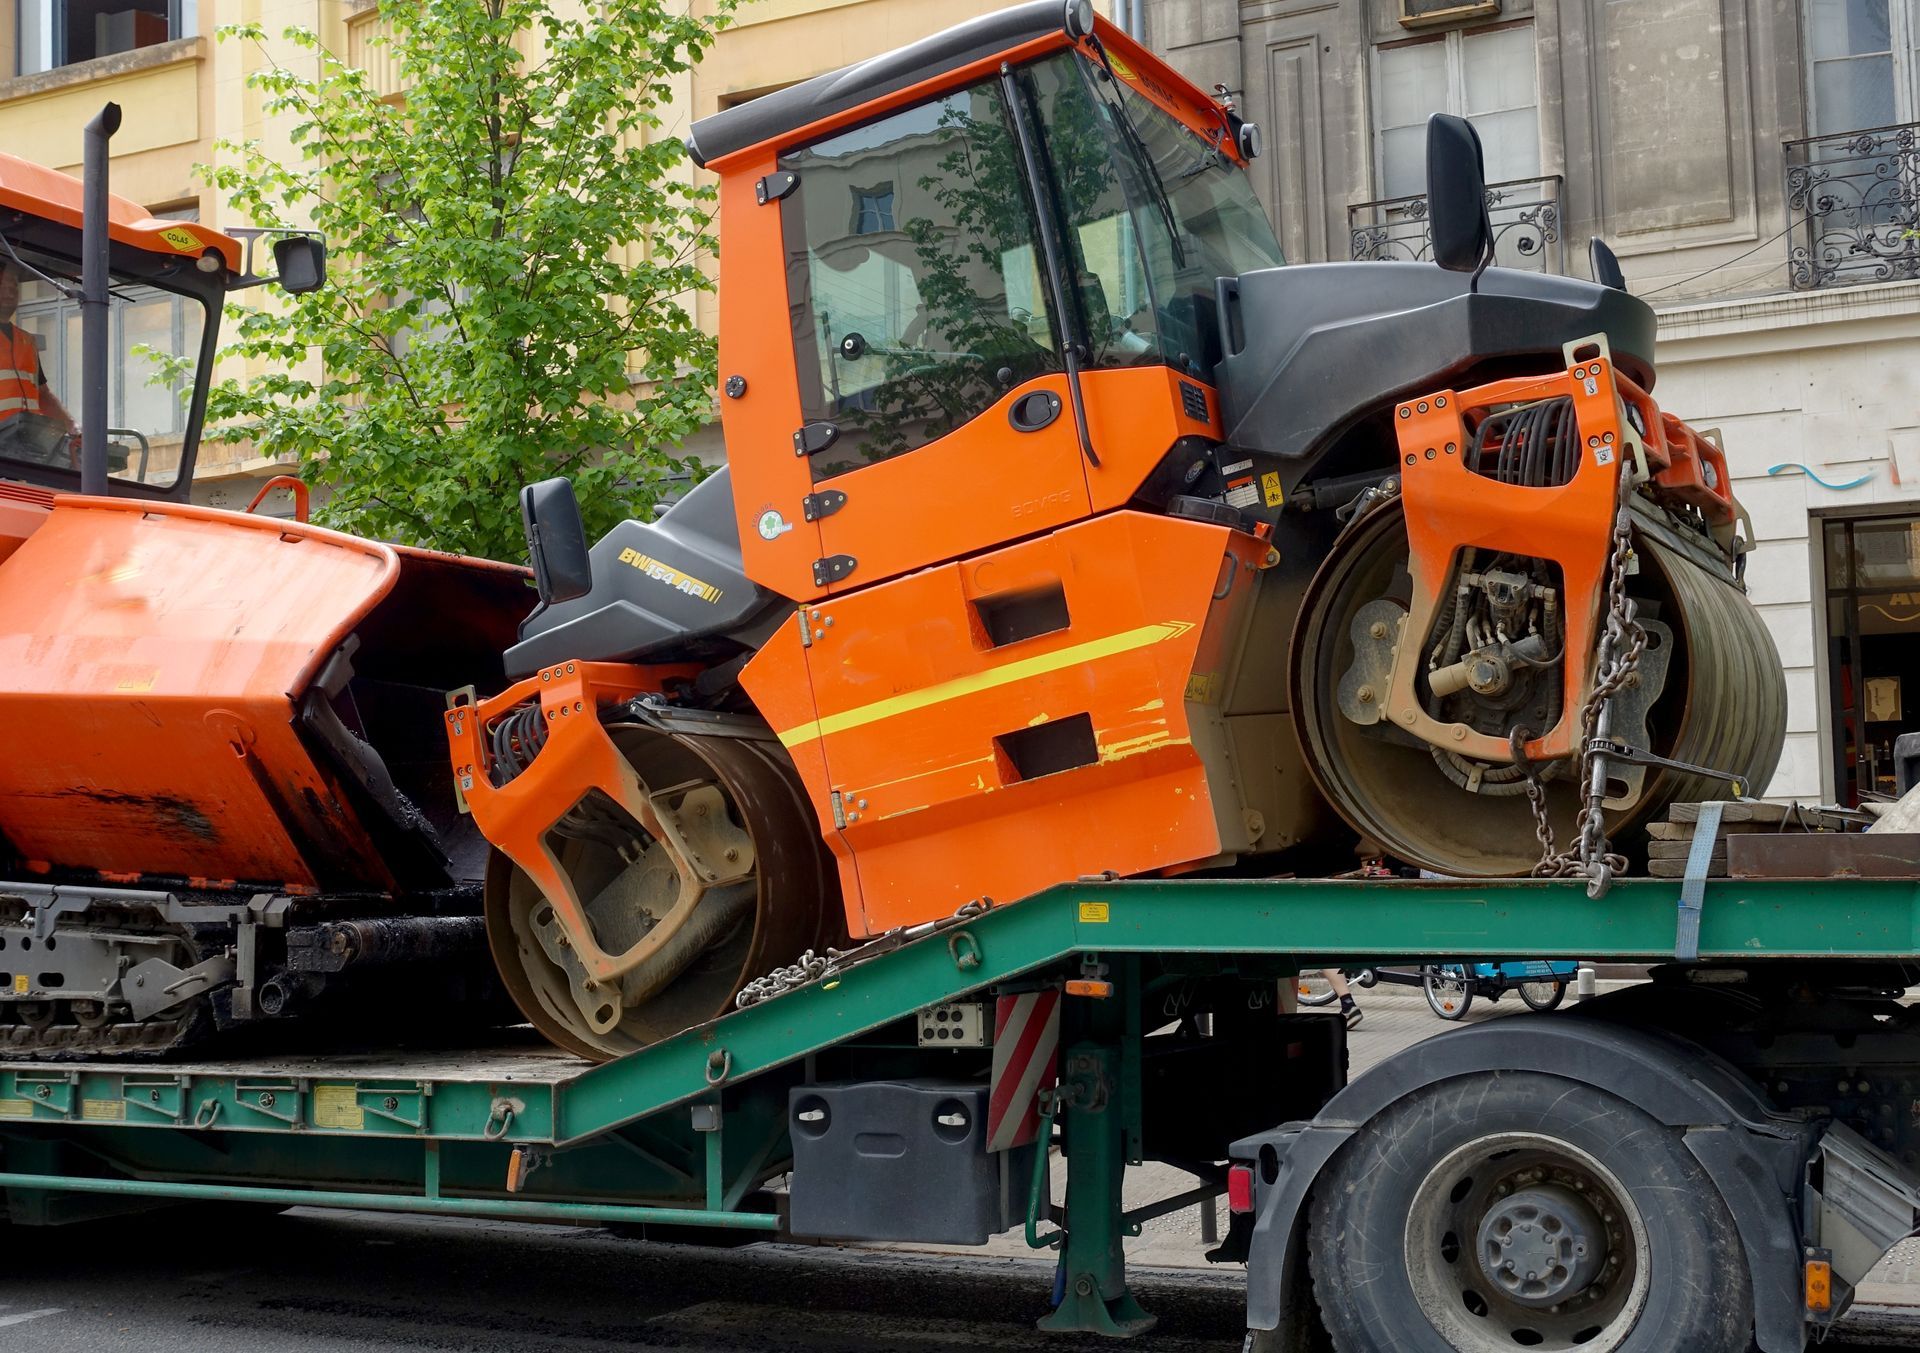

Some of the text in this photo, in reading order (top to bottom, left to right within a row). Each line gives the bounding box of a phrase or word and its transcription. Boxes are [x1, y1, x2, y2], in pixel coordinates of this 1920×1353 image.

[167, 232, 189, 245] COLAS
[1011, 489, 1072, 519] BOMAG
[675, 579, 705, 597] AP
